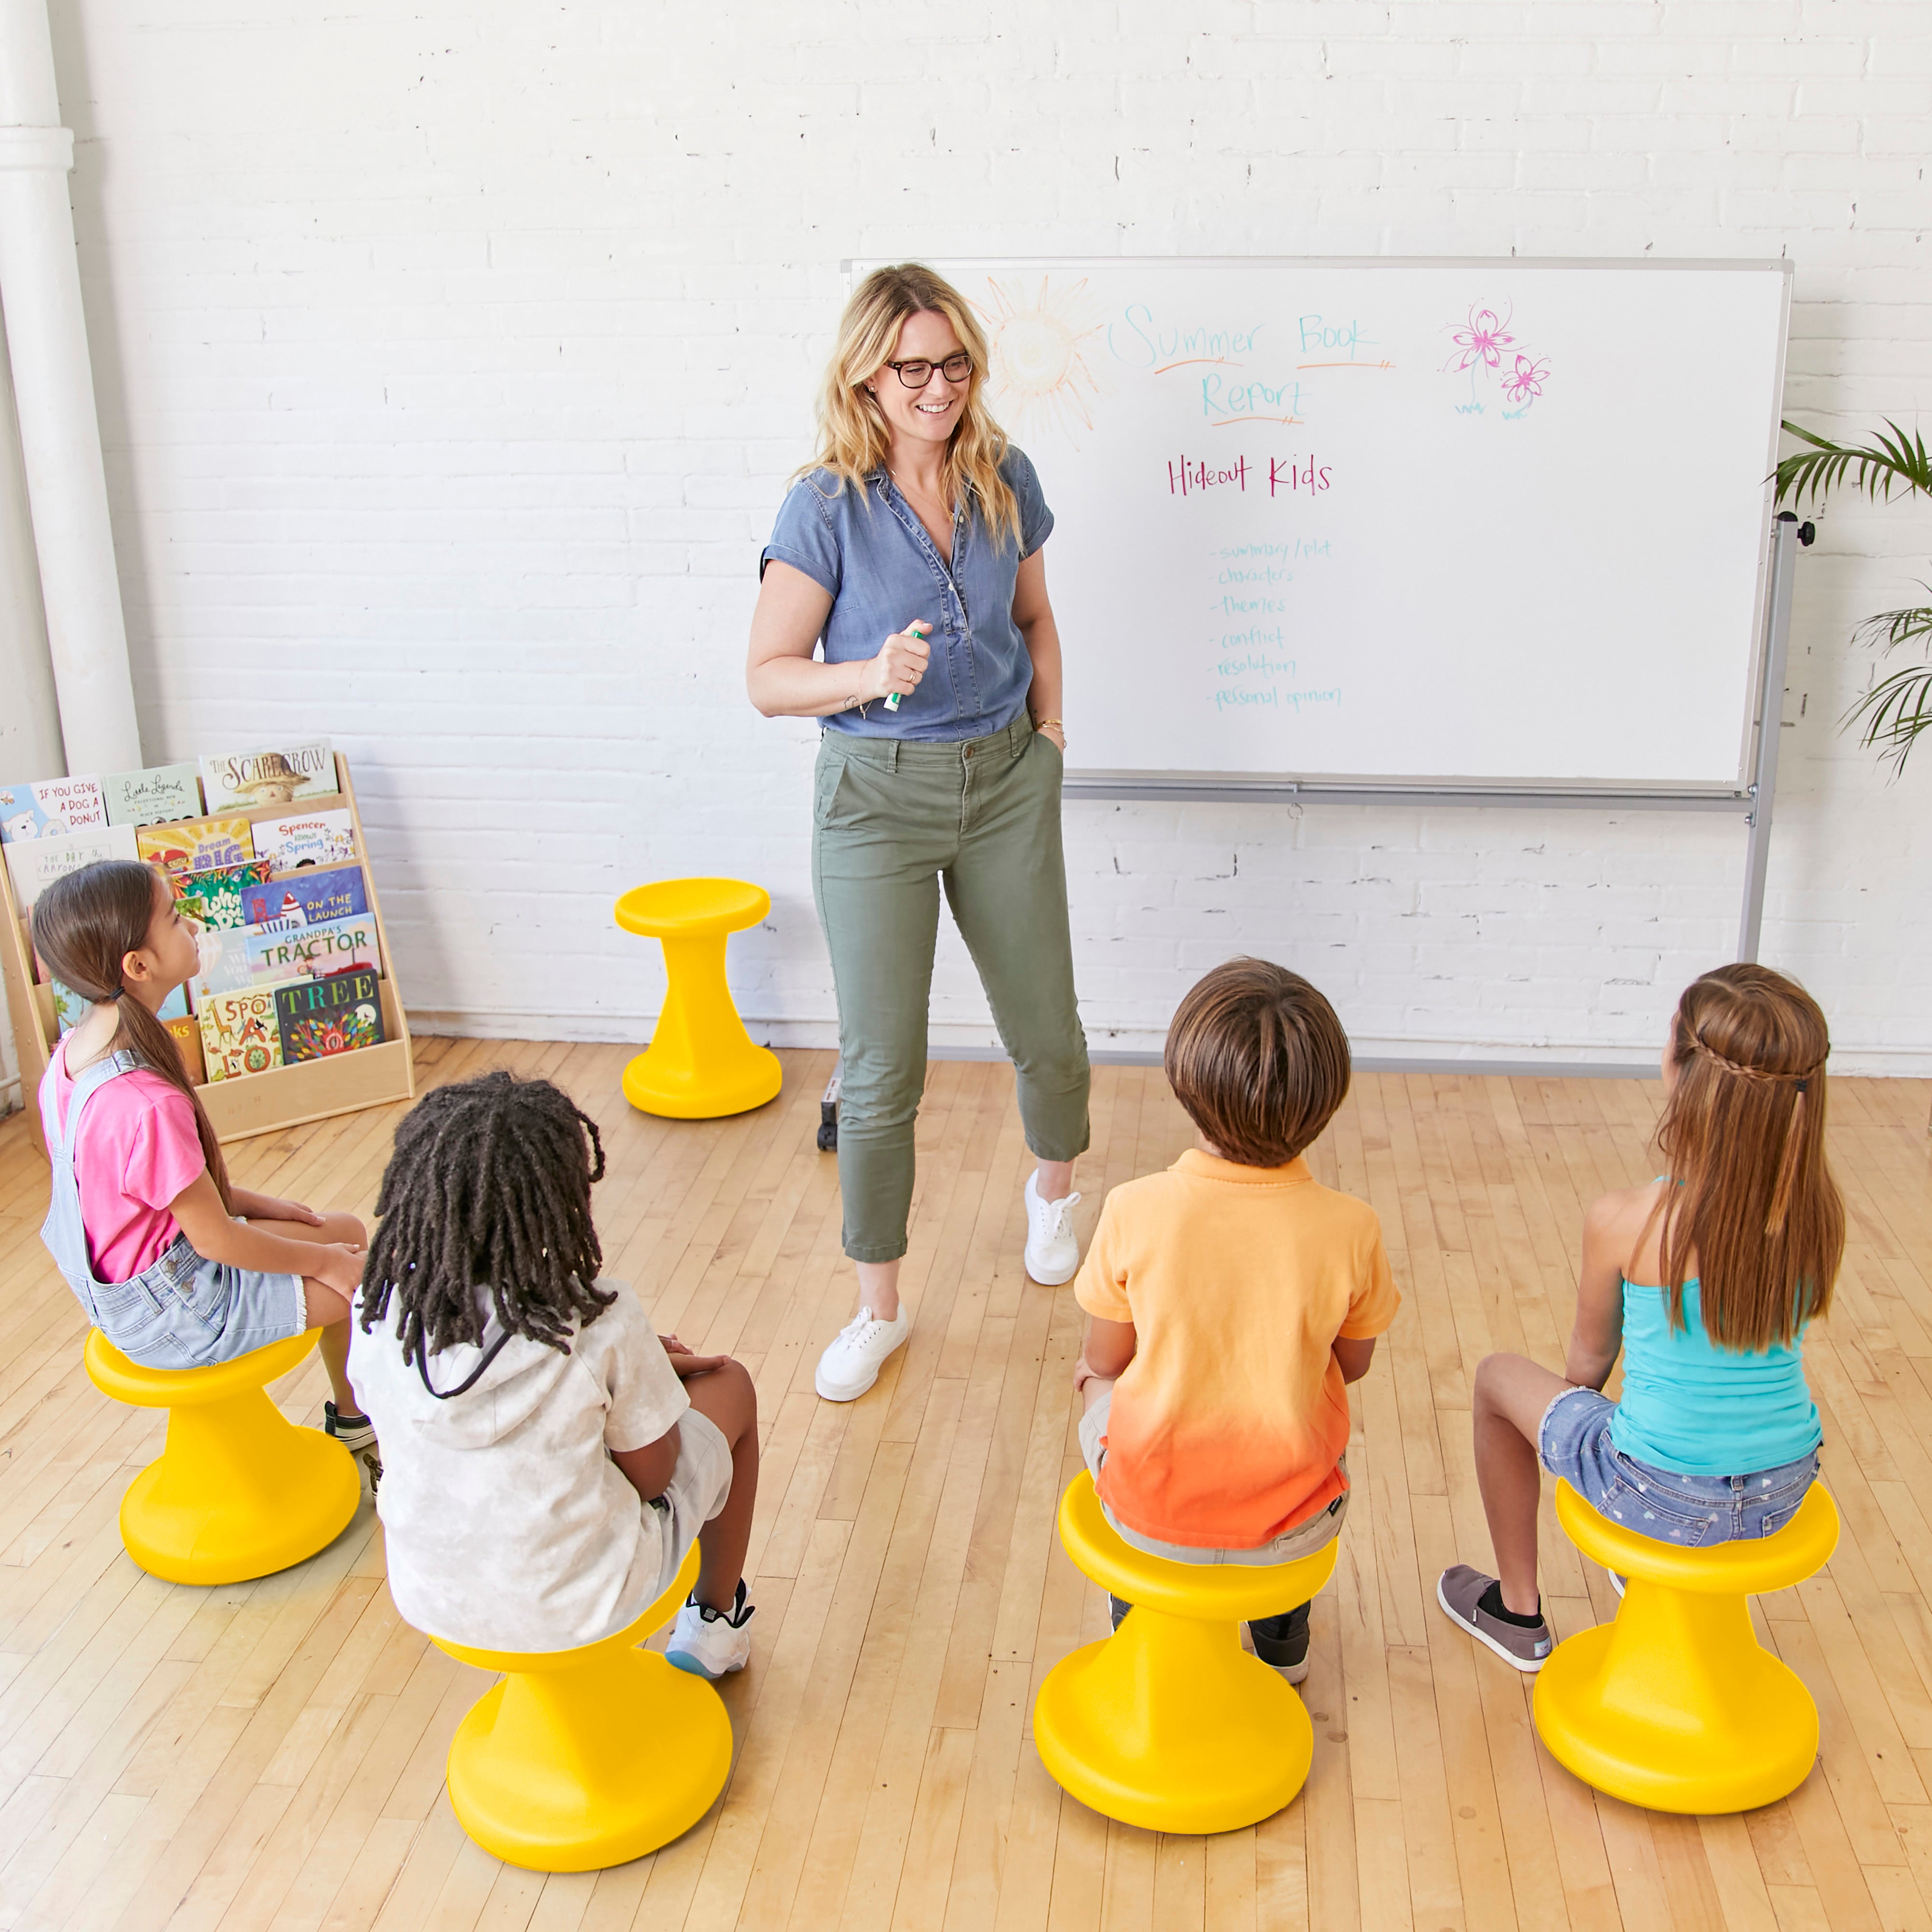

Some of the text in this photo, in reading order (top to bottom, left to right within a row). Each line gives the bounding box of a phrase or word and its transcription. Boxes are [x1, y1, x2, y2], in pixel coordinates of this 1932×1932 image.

[1108, 307, 1380, 368] Summer Book
[1202, 373, 1313, 416] Report
[1168, 454, 1332, 497] Hideout Kids
[1287, 688, 1341, 713] opinion
[210, 748, 326, 790] THE SCARECROW
[39, 783, 97, 800] IF YOU GIVE
[122, 775, 185, 802] Little Legends
[60, 797, 99, 812] A DOG A
[70, 811, 100, 825] DONUT
[279, 822, 326, 836] Spencer
[198, 838, 231, 853] Dream
[285, 839, 324, 855] Spring
[66, 852, 84, 862] DAY
[194, 844, 244, 870] BIG
[307, 894, 352, 910] ON THE
[308, 906, 352, 922] LAUNCH
[285, 925, 341, 944] GRANDPA'S
[261, 931, 367, 966] TRACTOR
[281, 975, 374, 1015] TREE
